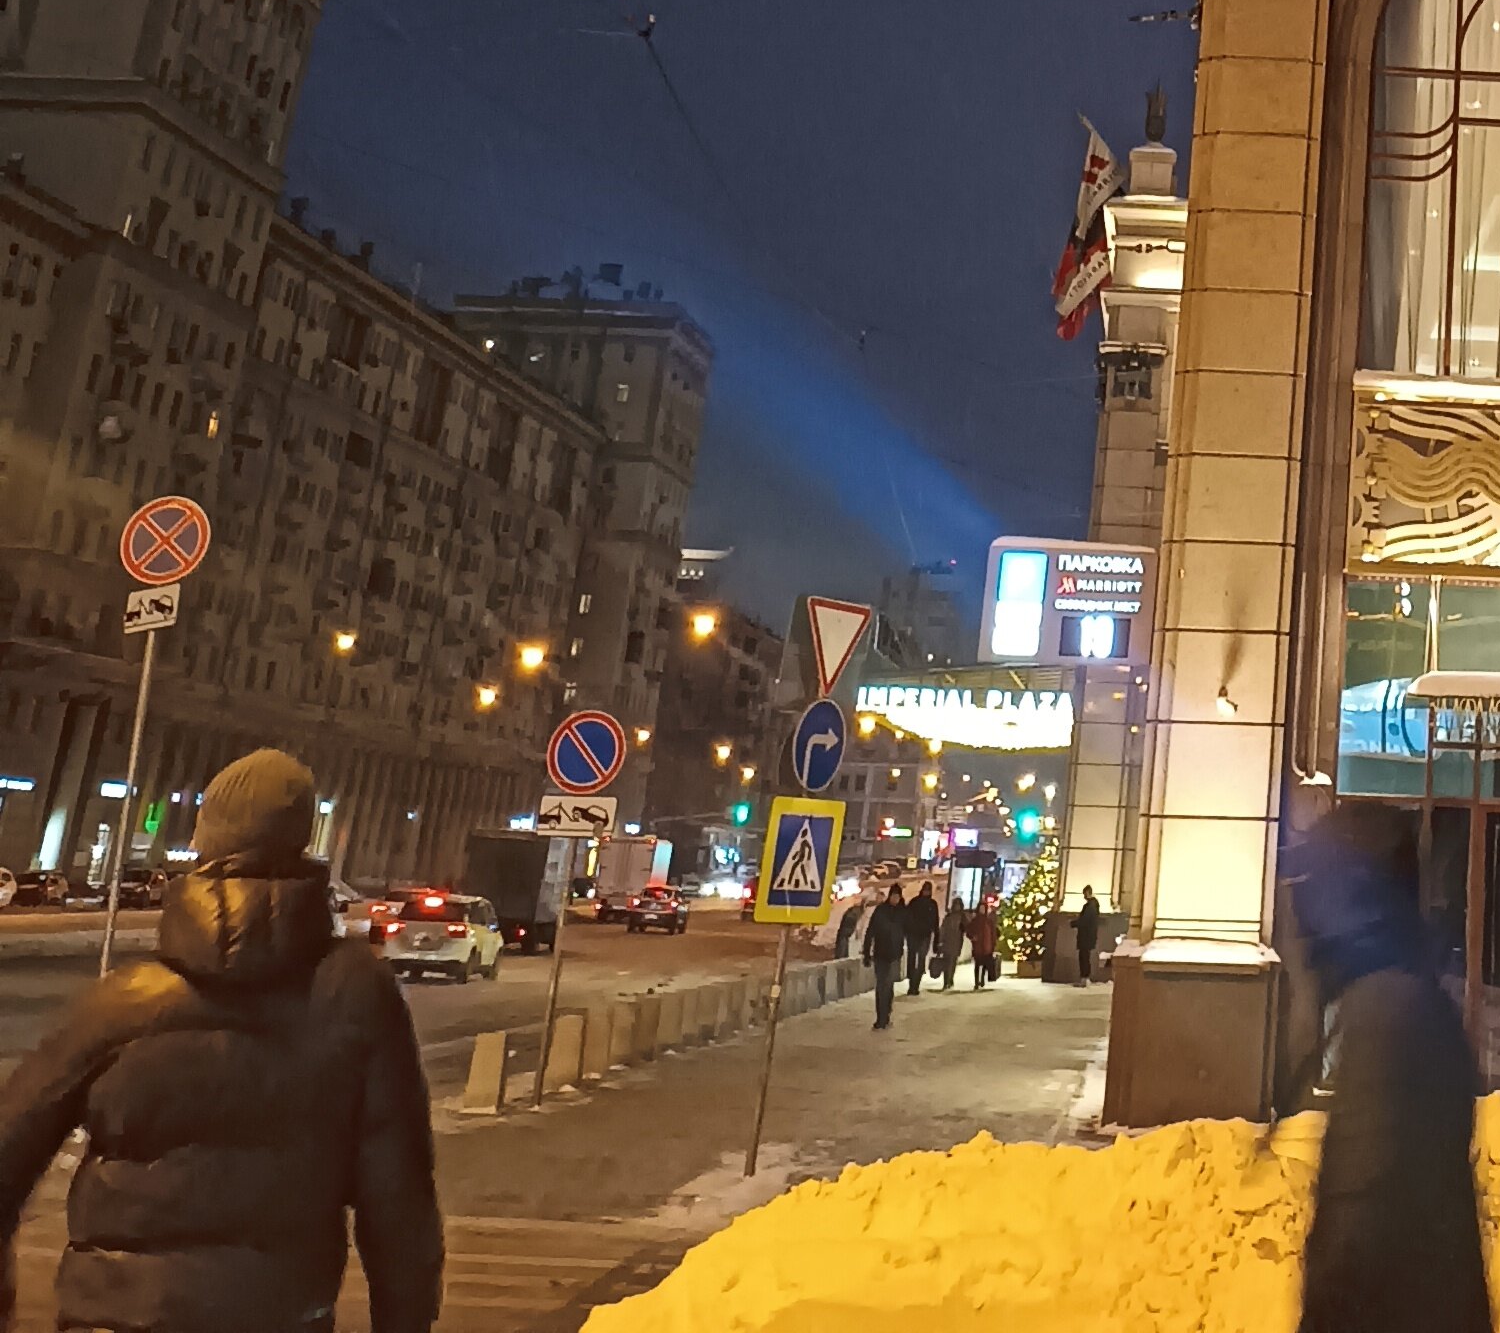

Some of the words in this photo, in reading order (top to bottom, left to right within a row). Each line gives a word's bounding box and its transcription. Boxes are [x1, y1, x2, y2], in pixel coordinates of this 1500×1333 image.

[1058, 554, 1144, 574] ПАРКОВКА
[1076, 579, 1143, 593] MARRIOTT
[856, 685, 977, 710] IMPERIAL
[985, 689, 1074, 714] PLAZA
